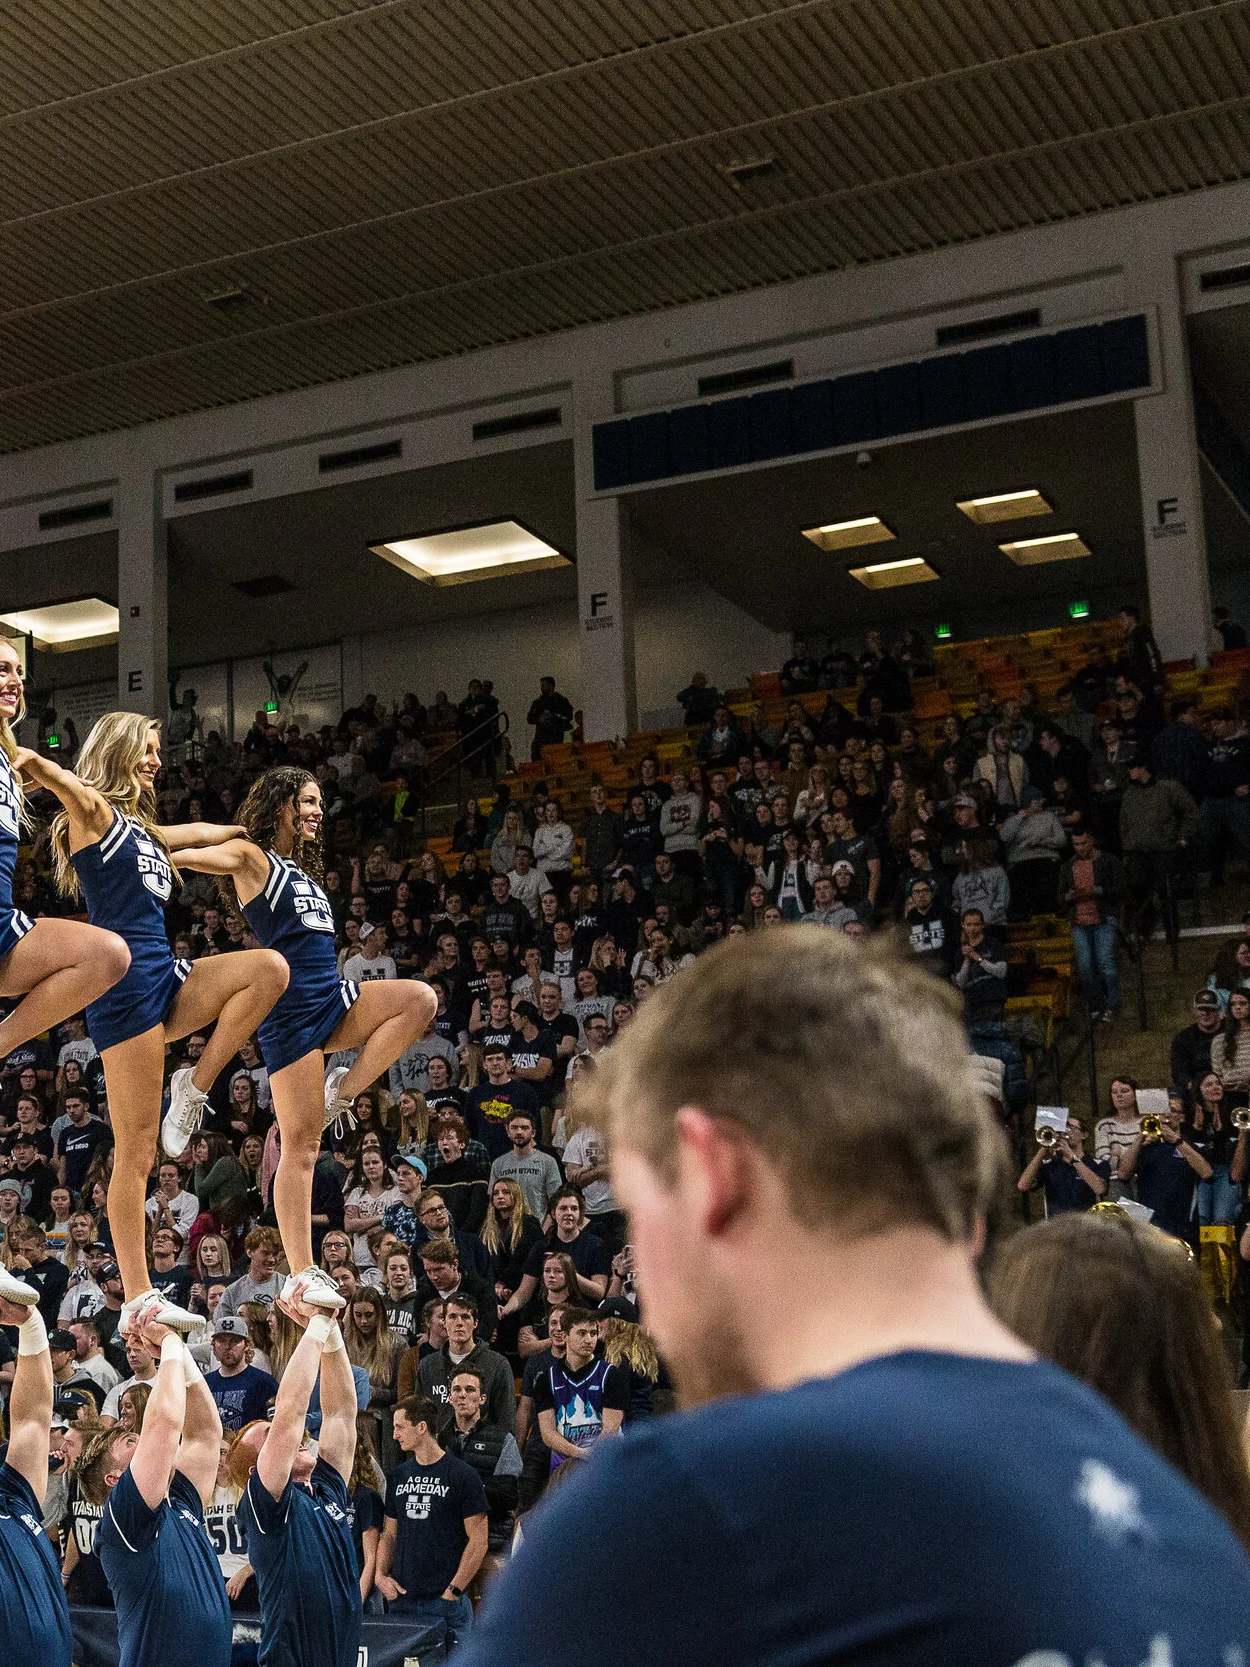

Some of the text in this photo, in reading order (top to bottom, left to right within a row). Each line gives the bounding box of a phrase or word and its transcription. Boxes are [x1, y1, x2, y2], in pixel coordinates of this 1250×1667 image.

[1157, 498, 1178, 525] F
[591, 592, 608, 617] F
[128, 670, 143, 692] E
[500, 1167, 539, 1177] UTAH STATE
[407, 1476, 440, 1484] AGGIE
[395, 1483, 450, 1498] GAMEDAY
[405, 1502, 431, 1511] STATE
